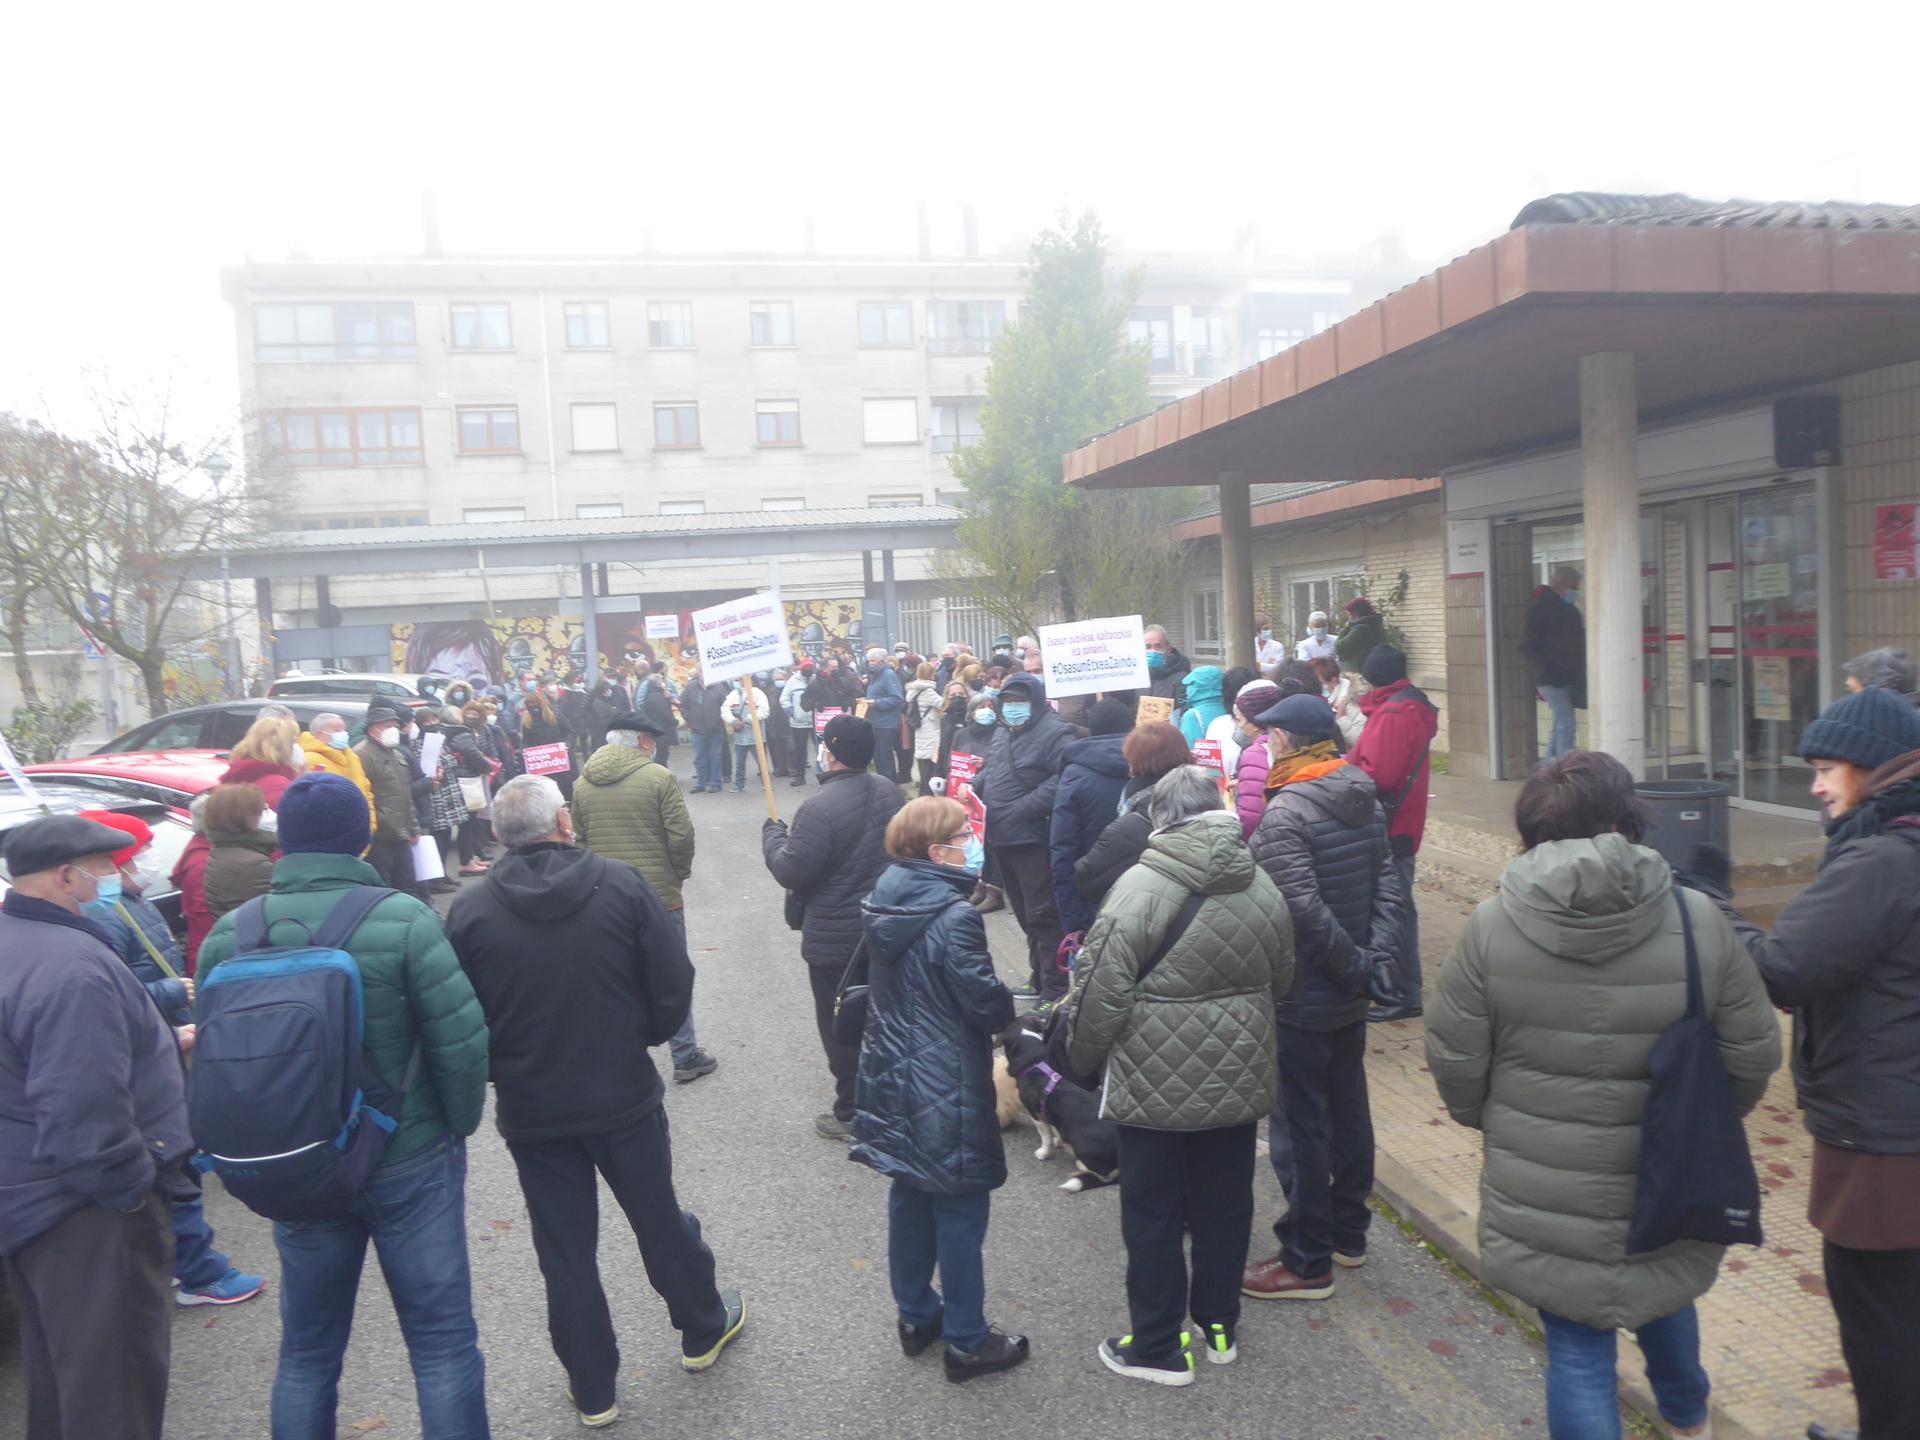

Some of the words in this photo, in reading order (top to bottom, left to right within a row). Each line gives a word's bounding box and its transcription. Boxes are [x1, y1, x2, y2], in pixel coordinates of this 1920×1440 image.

[707, 634, 779, 660] #OsasunEtxeaZaindu
[1052, 655, 1137, 676] #OsasunEtxeaZaindu
[528, 757, 568, 770] zaindu
